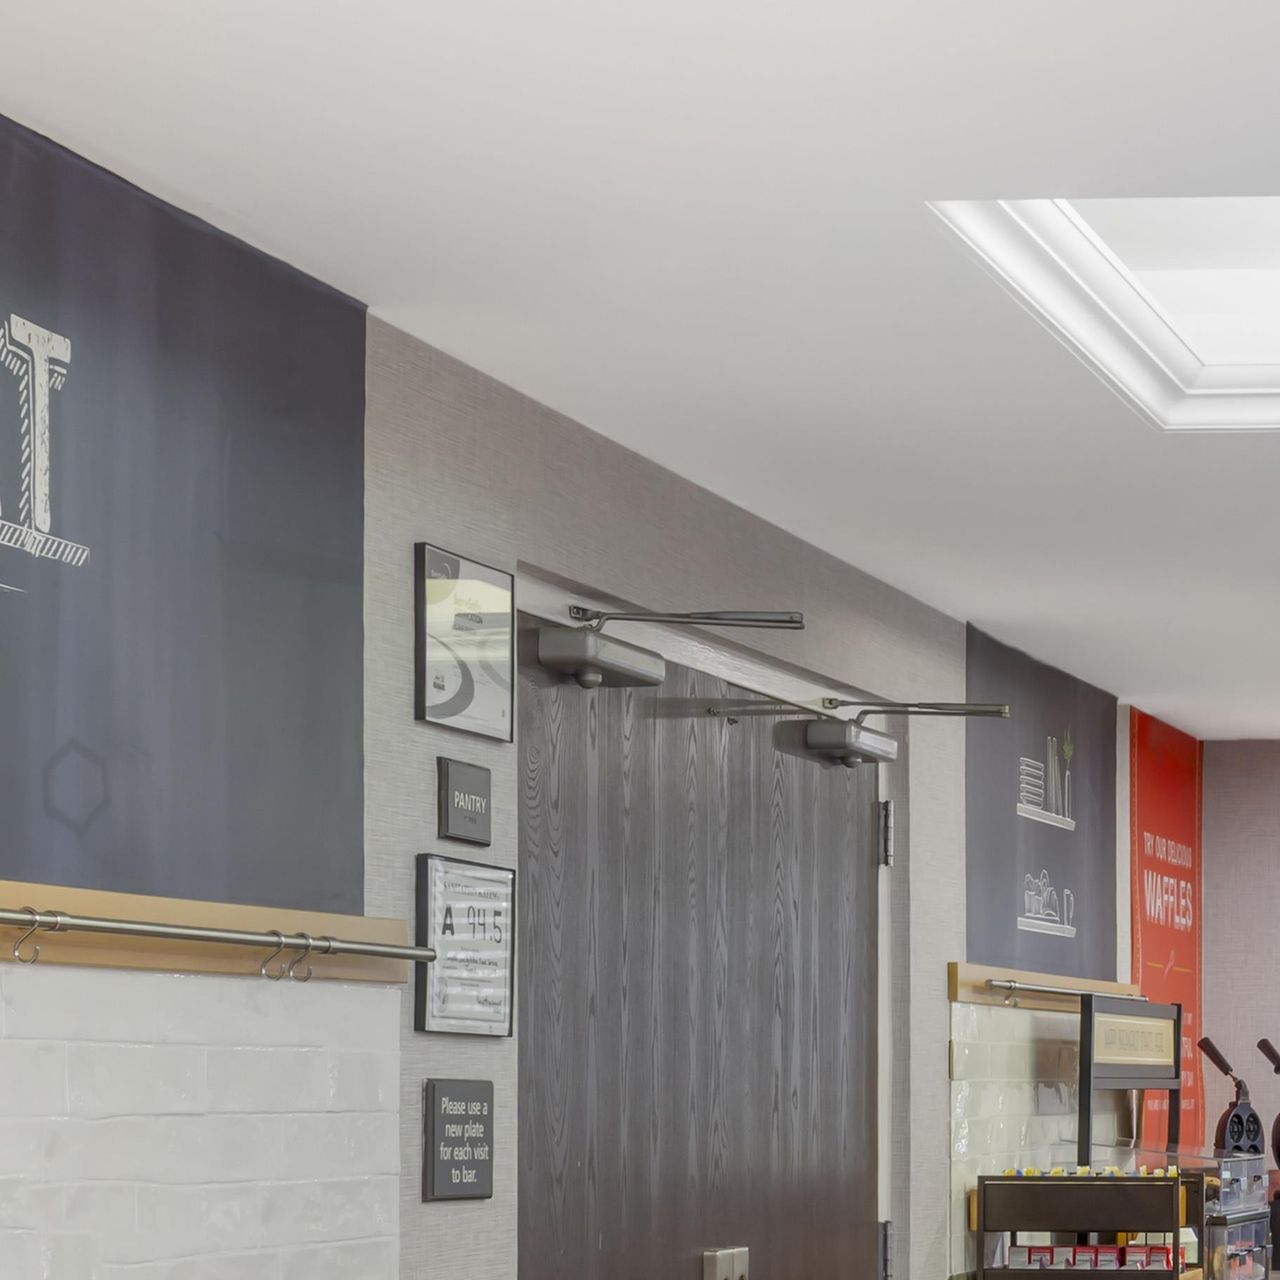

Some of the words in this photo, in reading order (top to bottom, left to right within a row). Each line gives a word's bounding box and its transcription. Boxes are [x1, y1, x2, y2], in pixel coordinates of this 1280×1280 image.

[454, 790, 487, 815] PANTRY
[1143, 868, 1193, 932] WAFFLES
[441, 905, 455, 936] A
[441, 1096, 466, 1114] Please
[467, 1102, 481, 1115] use
[482, 1102, 488, 1115] a
[445, 1123, 463, 1137] new
[464, 1120, 484, 1141] plate
[440, 1141, 452, 1160] for
[453, 1142, 472, 1160] each
[473, 1142, 489, 1160] visit
[451, 1167, 460, 1183] to
[462, 1165, 477, 1183] bar.
